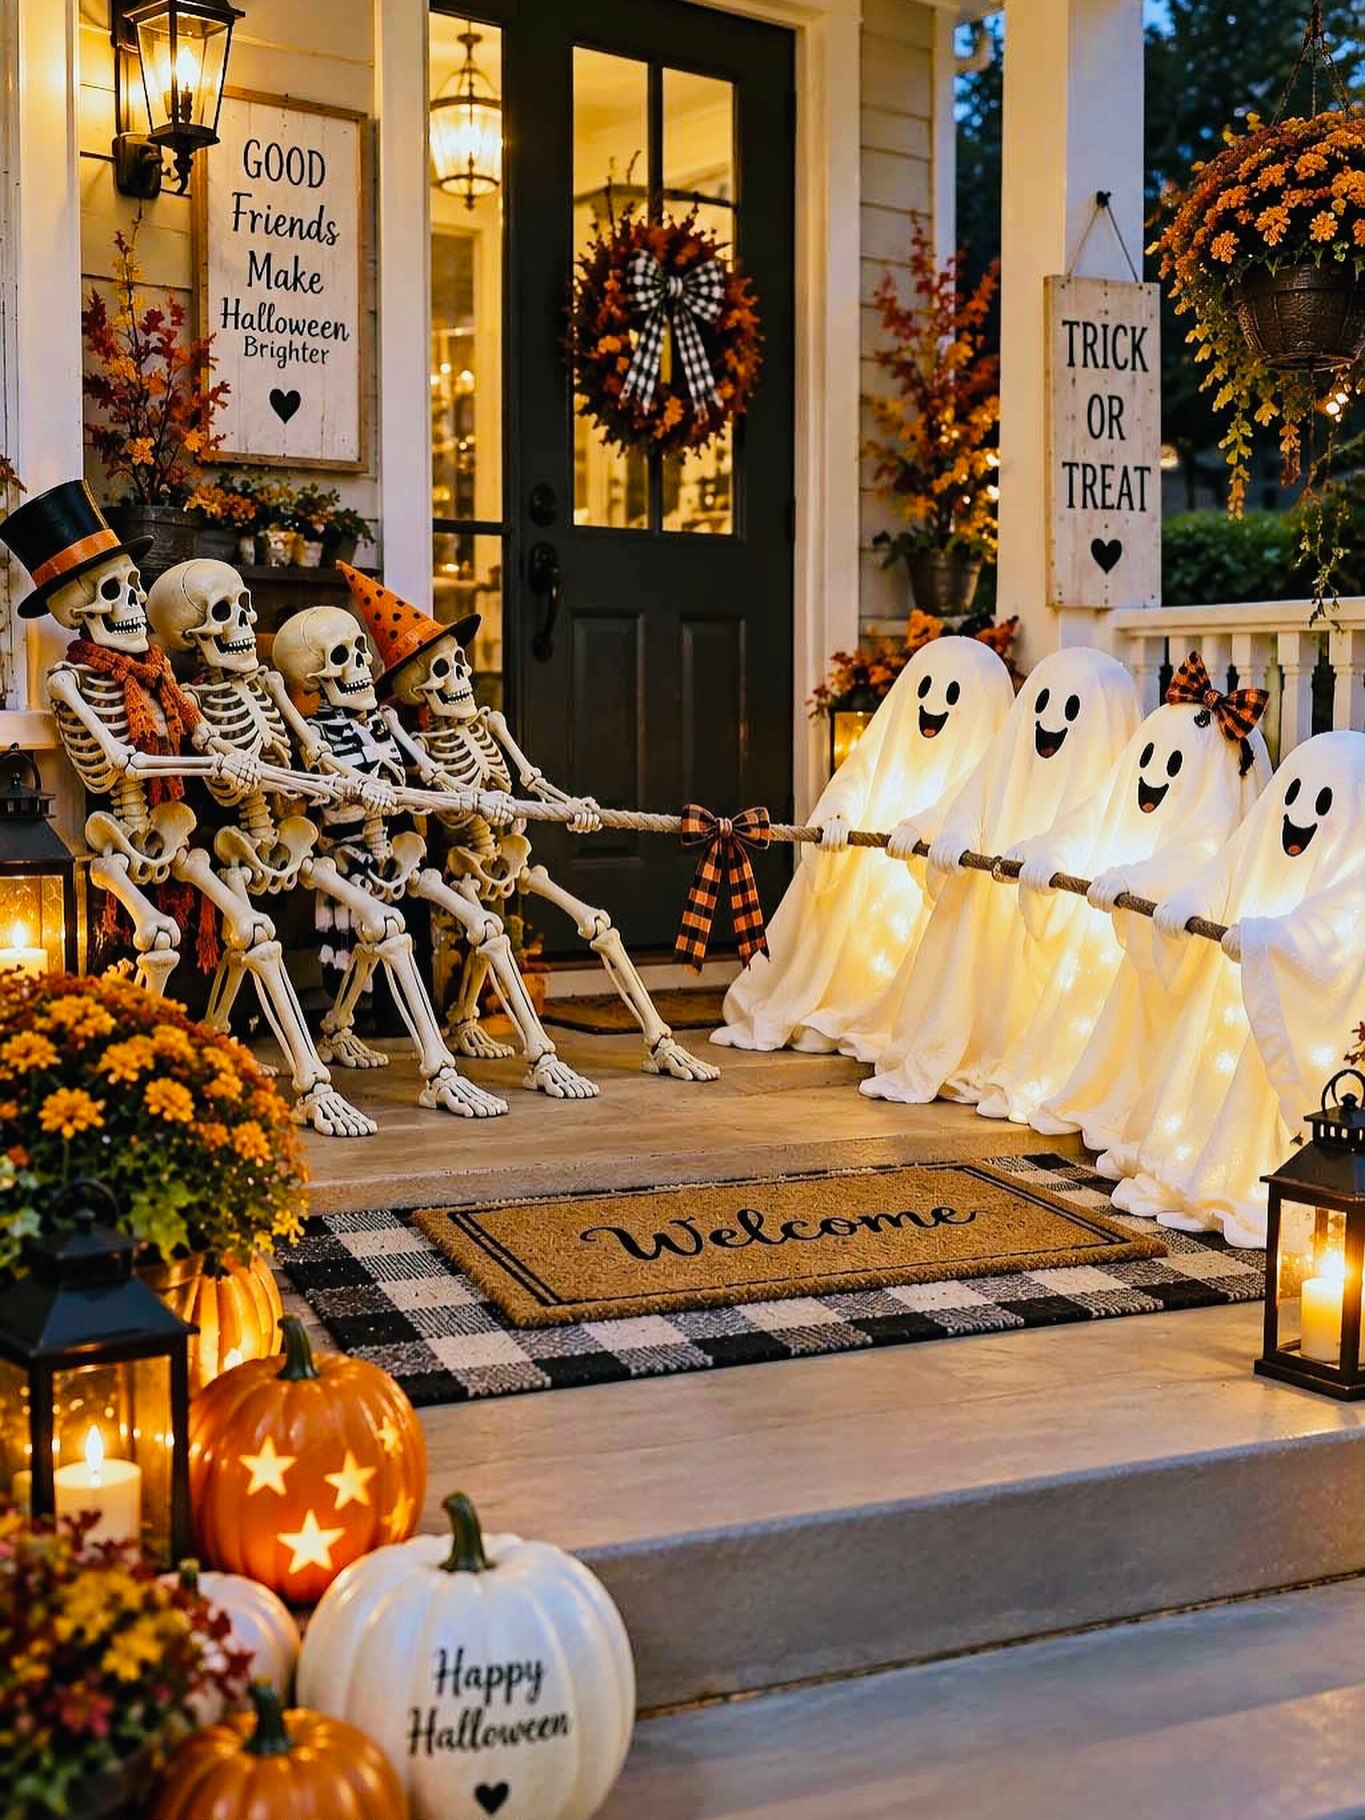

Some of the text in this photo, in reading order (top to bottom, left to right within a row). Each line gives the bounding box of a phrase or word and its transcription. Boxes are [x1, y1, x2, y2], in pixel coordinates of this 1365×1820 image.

[243, 138, 326, 189] GOOD
[231, 191, 340, 246] Friends
[247, 250, 324, 295] Make
[220, 297, 350, 342] Halloween
[243, 336, 330, 369] Brighter
[1062, 320, 1149, 372] TRICK
[1087, 394, 1126, 440] OR
[1062, 462, 1151, 512] TREAT
[580, 1206, 984, 1261] Welcome
[433, 1648, 544, 1705] Happy
[408, 1706, 569, 1756] Halloween
